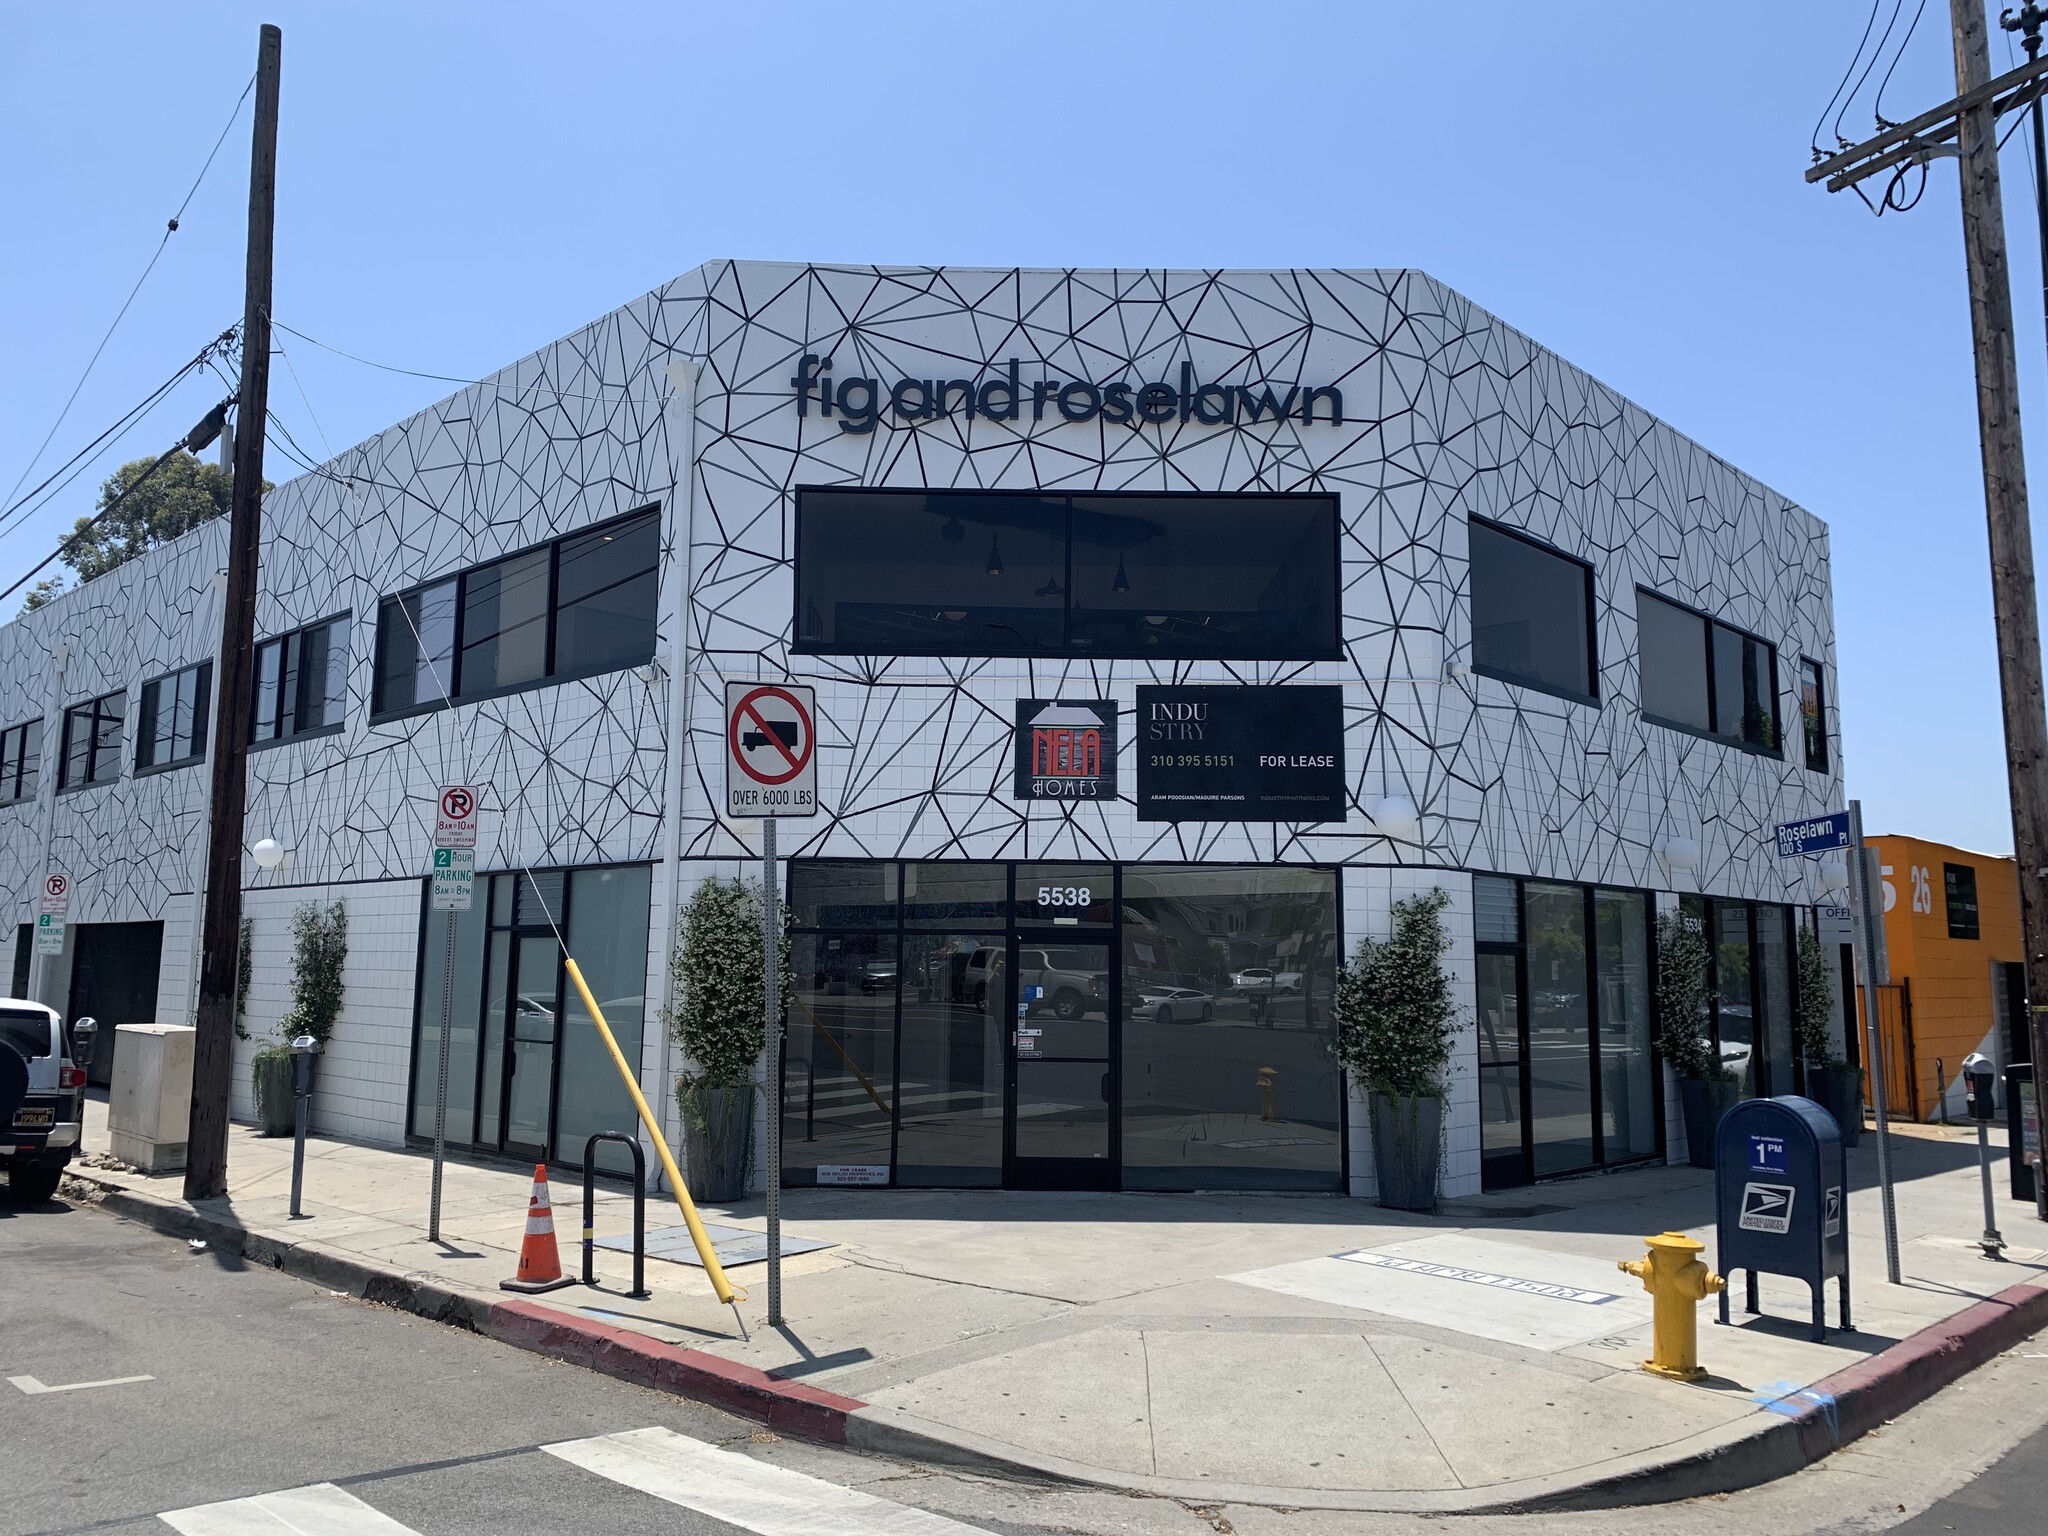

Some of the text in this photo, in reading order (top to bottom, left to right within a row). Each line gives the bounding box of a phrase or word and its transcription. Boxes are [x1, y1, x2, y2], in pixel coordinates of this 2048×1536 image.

[791, 354, 1344, 435] fig and roselawn
[1150, 703, 1208, 721] INDU
[1150, 723, 1208, 741] STRY
[1032, 728, 1100, 776] NELA
[1151, 755, 1235, 767] 310 395 5151
[1260, 755, 1335, 767] FOR LEASE
[1032, 779, 1098, 798] HOMES
[733, 790, 812, 805] OVER 6000 LBS
[438, 820, 452, 830] 8AM
[458, 820, 474, 830] 10AM
[1778, 820, 1833, 844] Roselawn
[1780, 840, 1803, 855] 100 S
[438, 851, 472, 865] 2 HOUR
[435, 870, 472, 882] PARKING
[435, 884, 449, 895] 8AM
[456, 885, 470, 895] 8PM
[1038, 887, 1091, 906] 5538
[42, 915, 48, 926] 2
[1826, 908, 1850, 918] OFFI
[40, 928, 63, 936] PARKING
[1756, 1143, 1782, 1163] 1 PM
